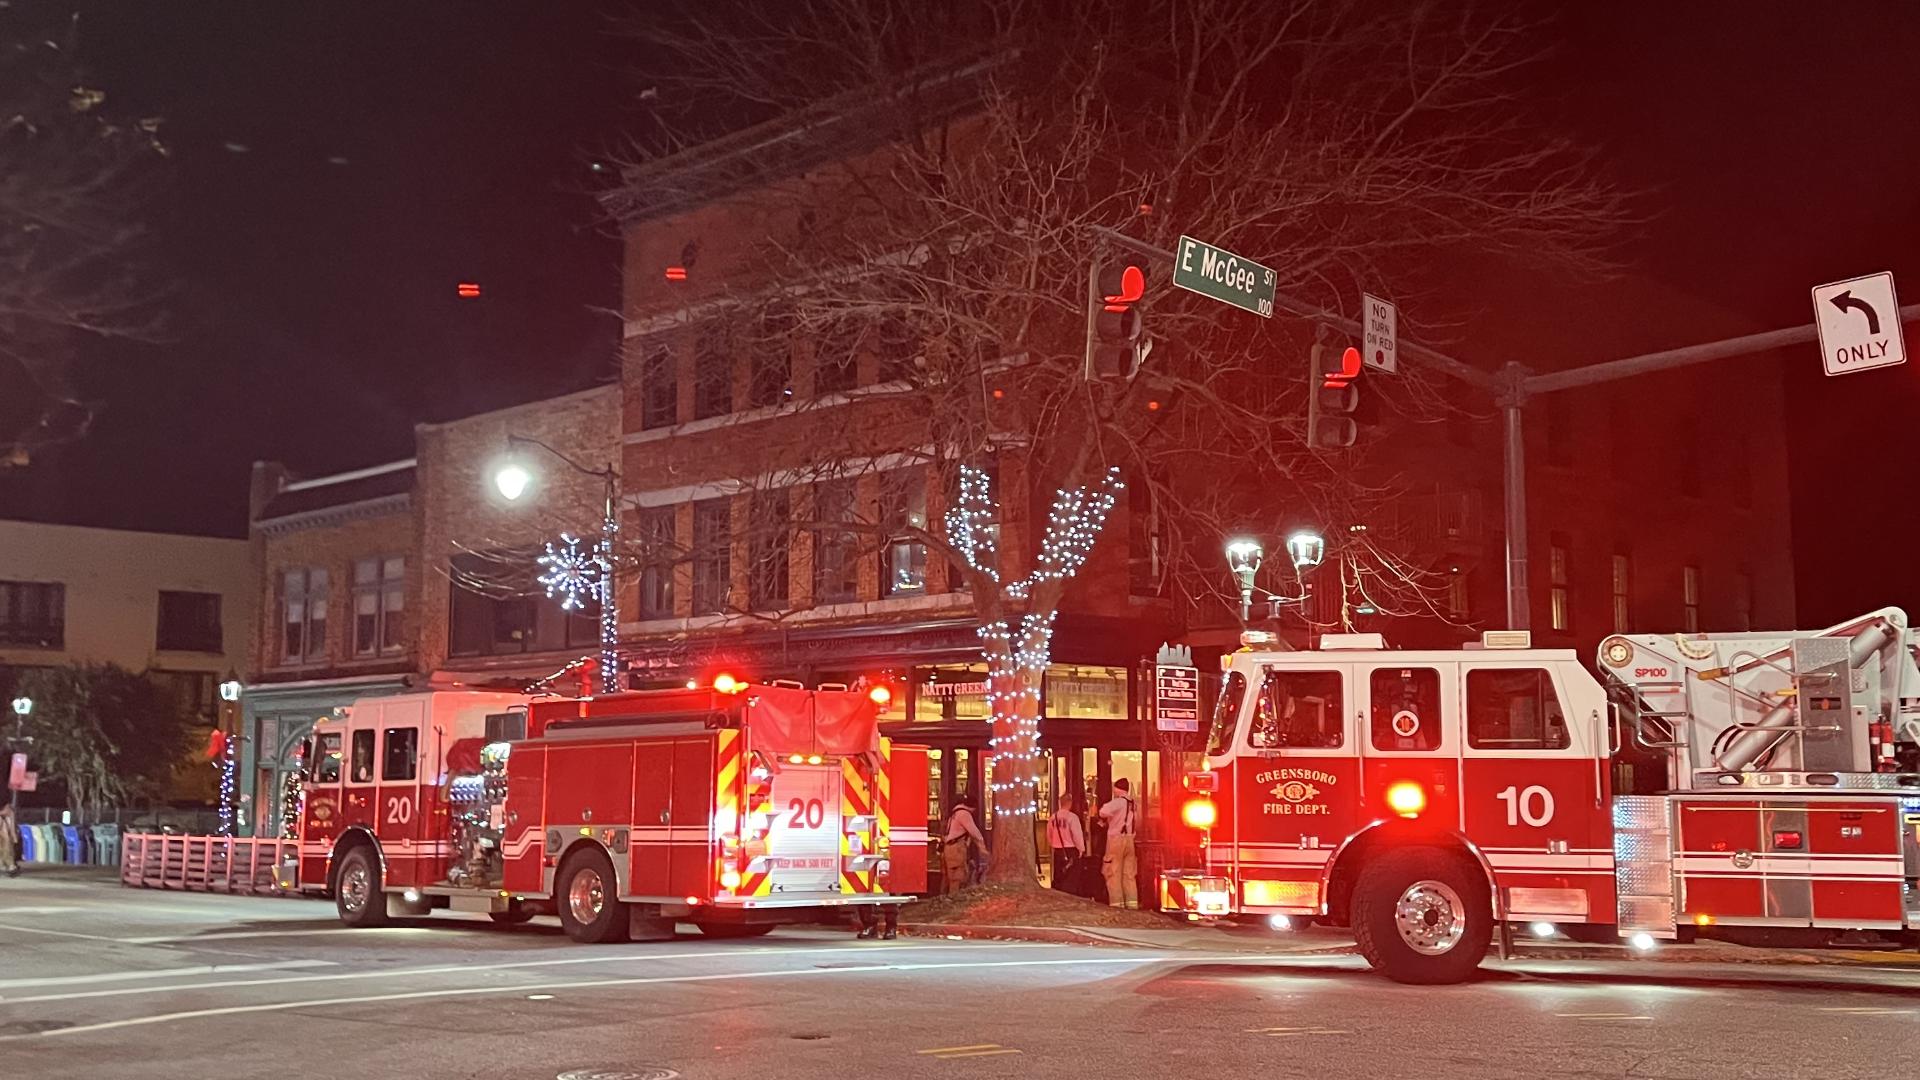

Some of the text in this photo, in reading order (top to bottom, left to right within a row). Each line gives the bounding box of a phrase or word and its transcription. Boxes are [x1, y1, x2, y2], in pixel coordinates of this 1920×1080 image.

[1182, 241, 1273, 293] E McGee St
[1258, 298, 1272, 315] 100
[1372, 303, 1387, 319] NO
[1371, 320, 1390, 335] TURN
[1366, 332, 1394, 351] ON RED
[1837, 339, 1889, 364] ONLY
[1635, 668, 1667, 678] SP100
[922, 682, 954, 697] NATTY
[1256, 768, 1337, 786] GREENSBORO
[387, 796, 411, 824] 20
[788, 797, 824, 829] 20
[1263, 803, 1331, 815] FIRE DEPT.
[1496, 785, 1555, 827] 10
